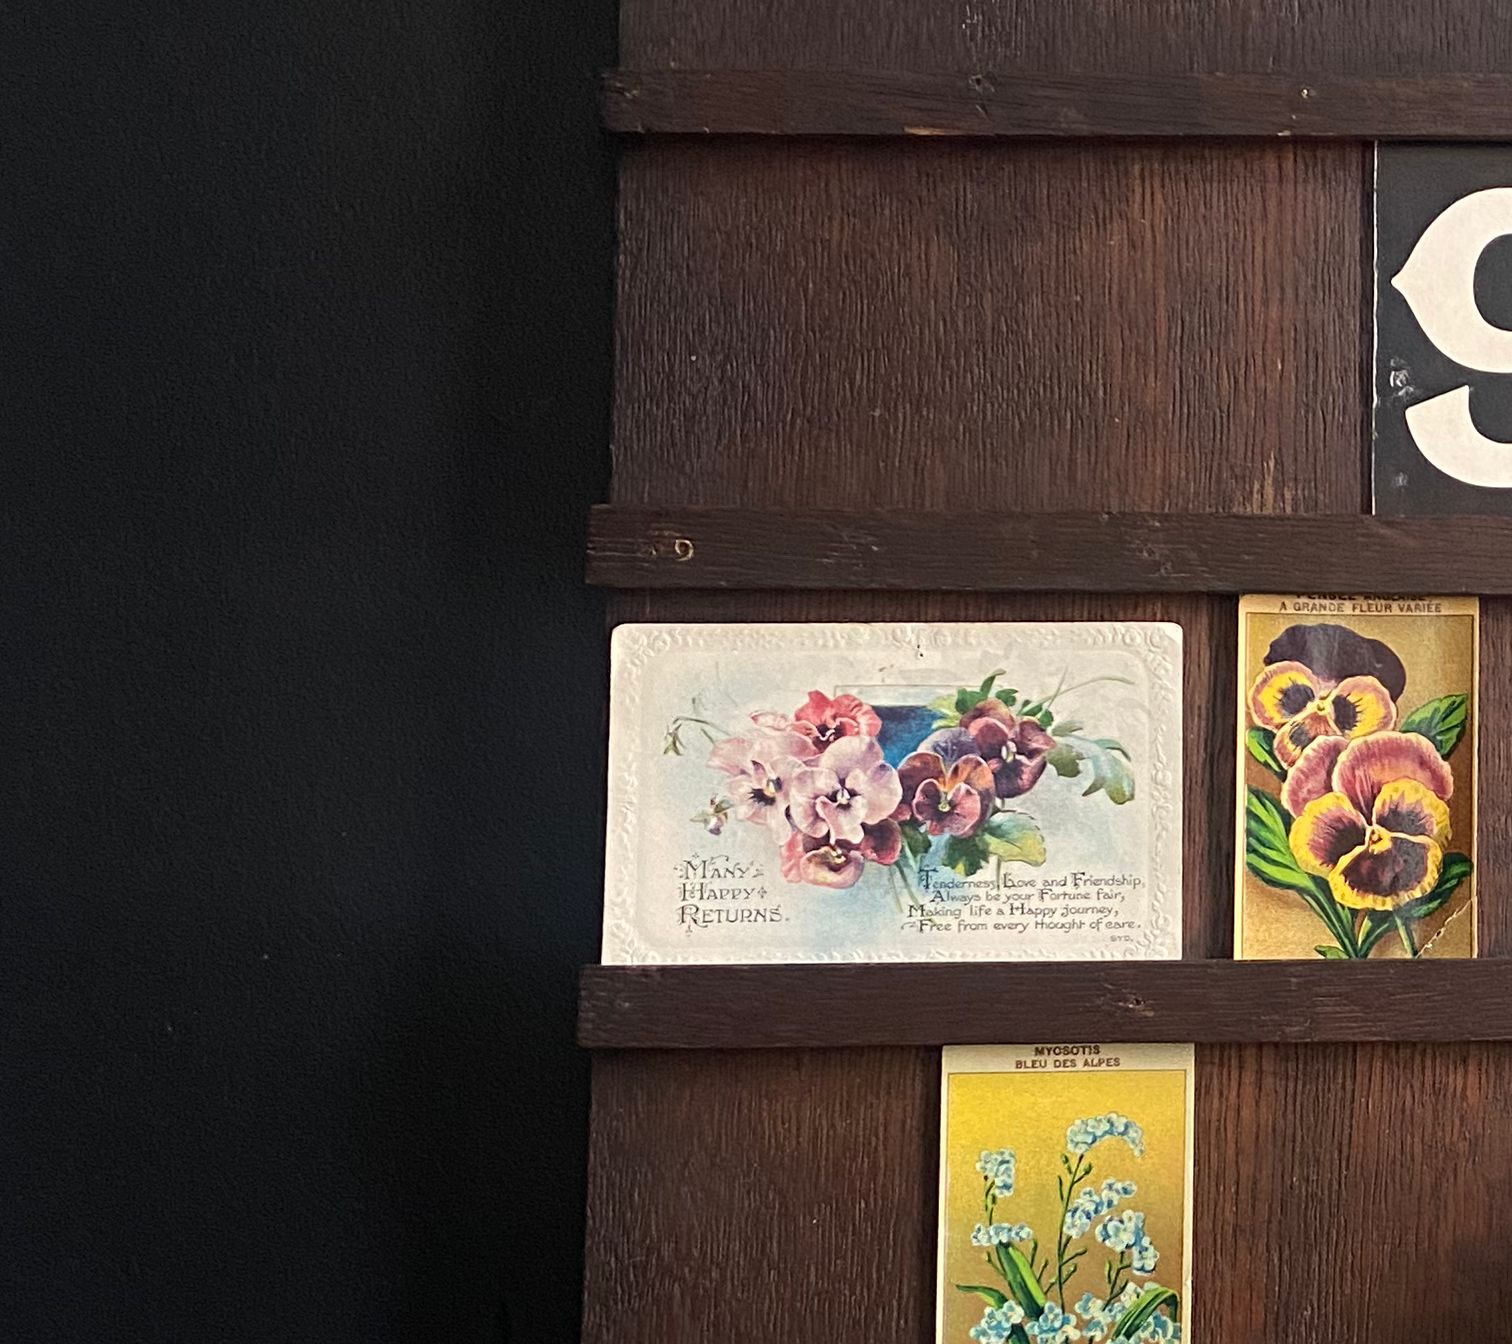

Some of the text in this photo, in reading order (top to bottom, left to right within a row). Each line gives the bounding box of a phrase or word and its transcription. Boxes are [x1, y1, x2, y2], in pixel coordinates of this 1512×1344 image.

[1293, 601, 1345, 613] GRANDE
[1352, 601, 1393, 613] FLEUR
[1398, 599, 1442, 613] VARIÉE
[680, 855, 753, 880] MANY
[1003, 873, 1037, 889] Love
[1042, 876, 1068, 887] and
[679, 882, 755, 901] HAPPY
[930, 887, 1125, 906] Always be your Fortune fair,
[907, 902, 1119, 919] Making life a Happy journey,
[918, 918, 953, 933] Free
[957, 919, 988, 933] from
[993, 921, 1029, 934] every
[1034, 918, 1086, 933] thought
[1089, 917, 1103, 931] of
[1034, 1044, 1101, 1056] MYOSOTIS
[1015, 1057, 1121, 1069] BLEU DES ALPES
